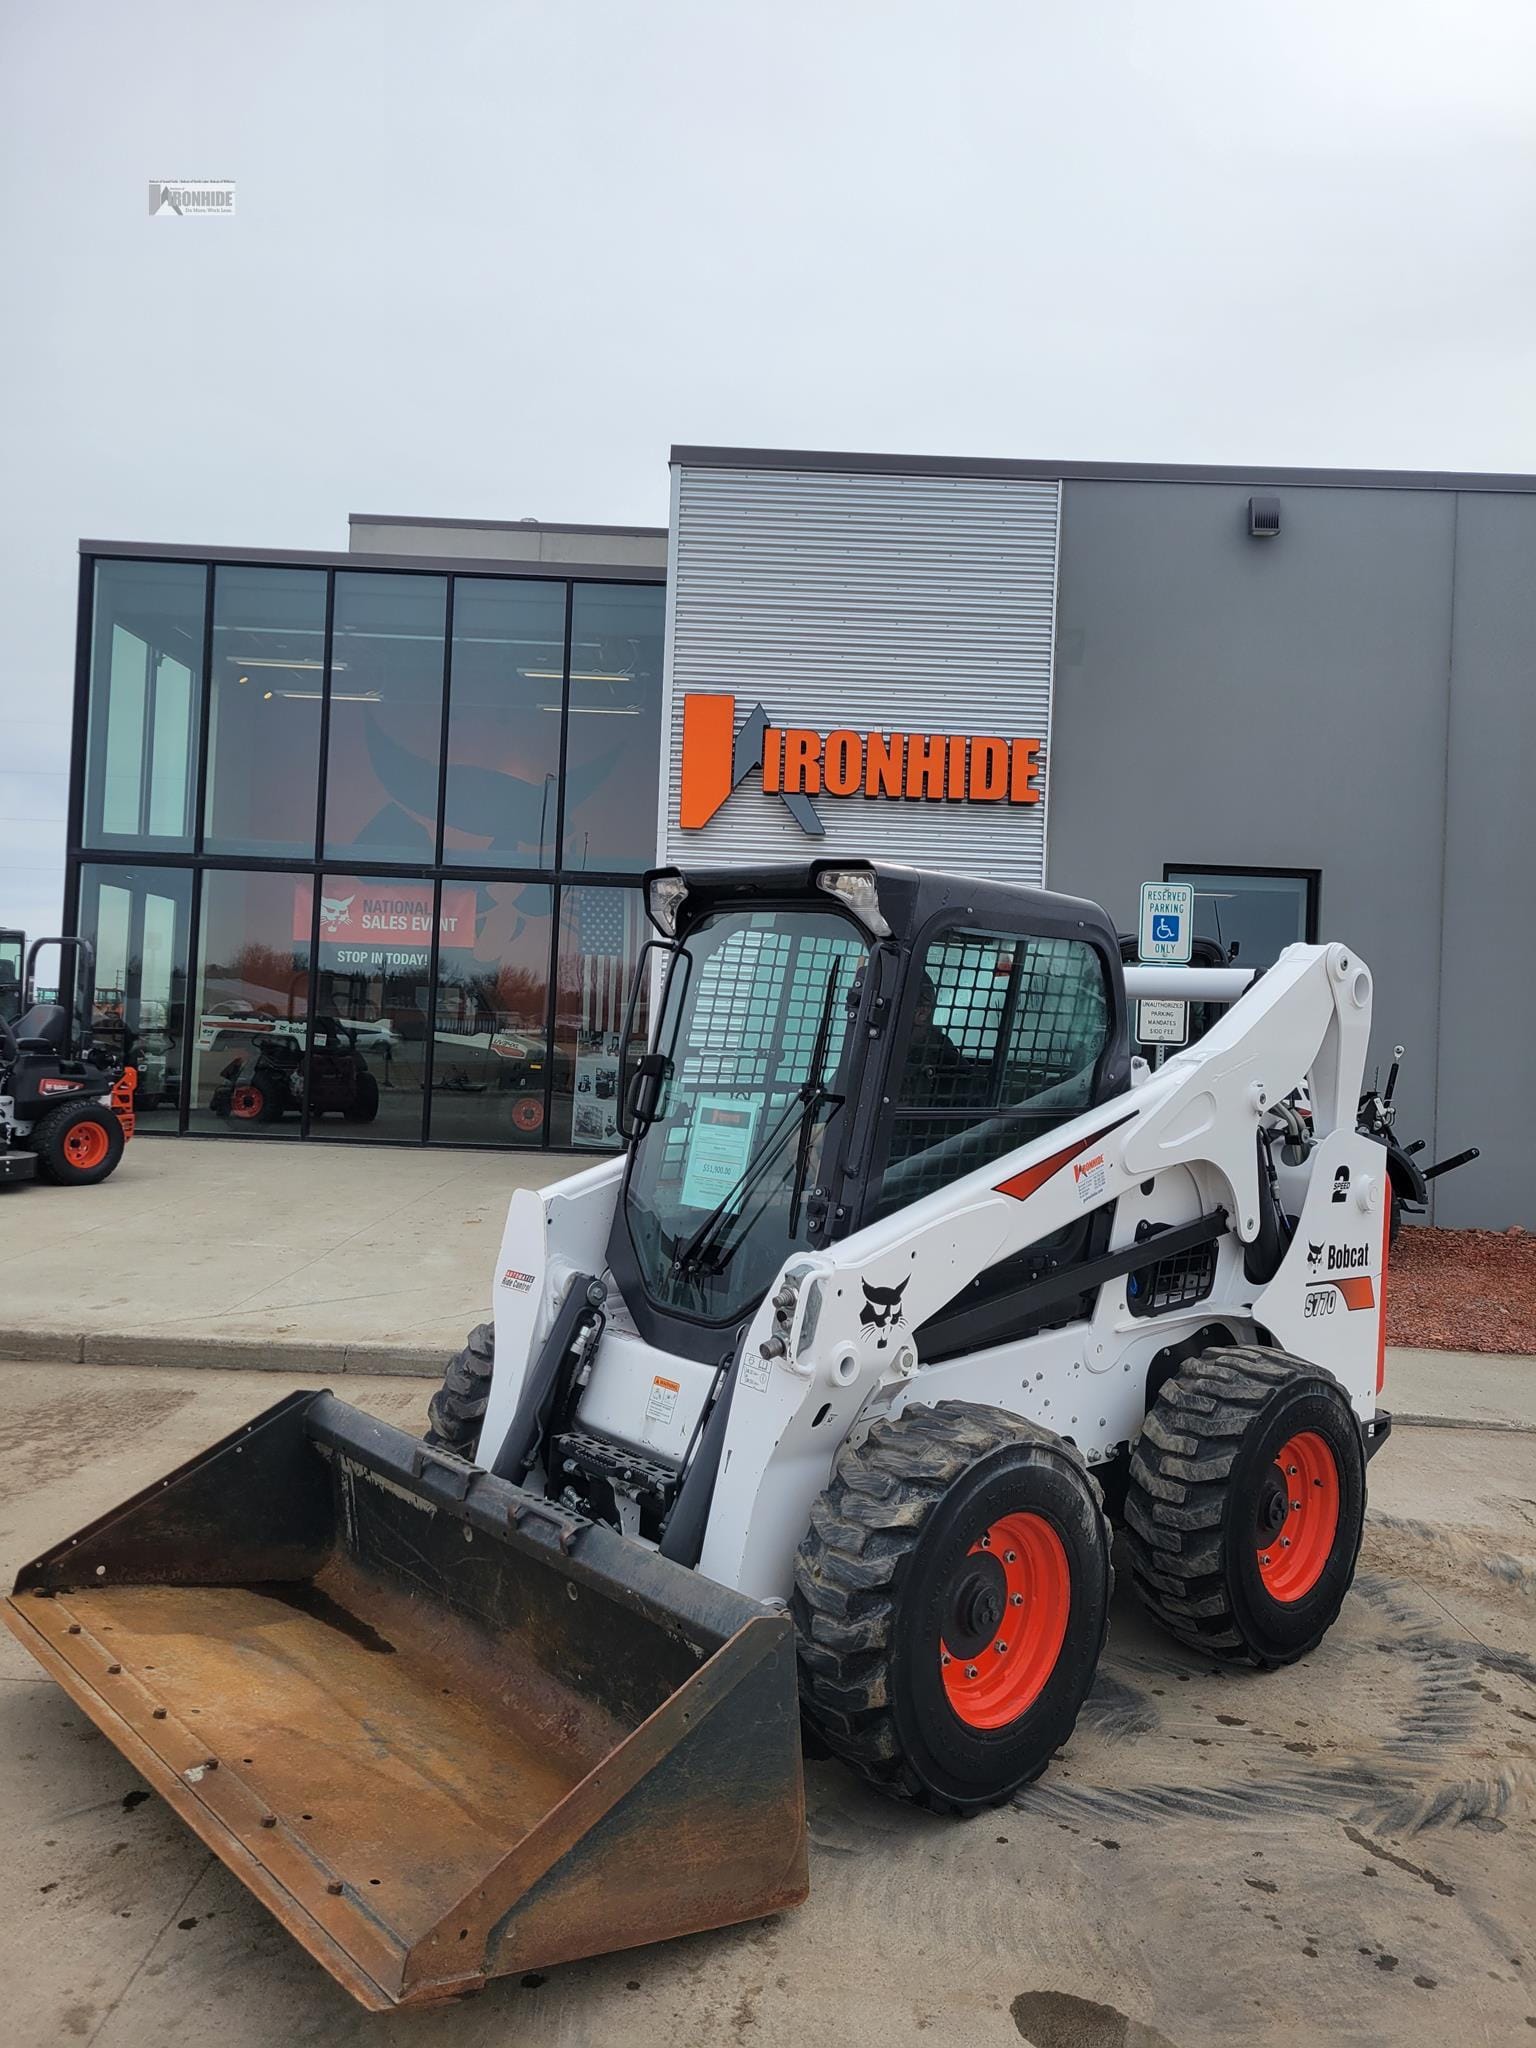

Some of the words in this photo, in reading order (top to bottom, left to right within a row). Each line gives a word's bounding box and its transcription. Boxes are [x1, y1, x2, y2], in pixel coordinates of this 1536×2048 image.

[762, 727, 1041, 803] IRONHIDE
[1147, 891, 1187, 901] RESERVED
[363, 899, 432, 916] NATIONAL
[1149, 903, 1185, 913] PARKING
[361, 914, 407, 931] SALES
[412, 916, 458, 932] EVNT
[1154, 943, 1176, 954] ONLY
[336, 950, 368, 964] STOP
[371, 952, 383, 965] IN
[385, 953, 429, 966] TODAY!
[1142, 1001, 1184, 1009] UNAUTHORIZED
[289, 1026, 307, 1035] Bobca
[1333, 1182, 1351, 1191] SPEED
[1327, 1243, 1369, 1270] Bobcat
[1304, 1290, 1337, 1318] S770
